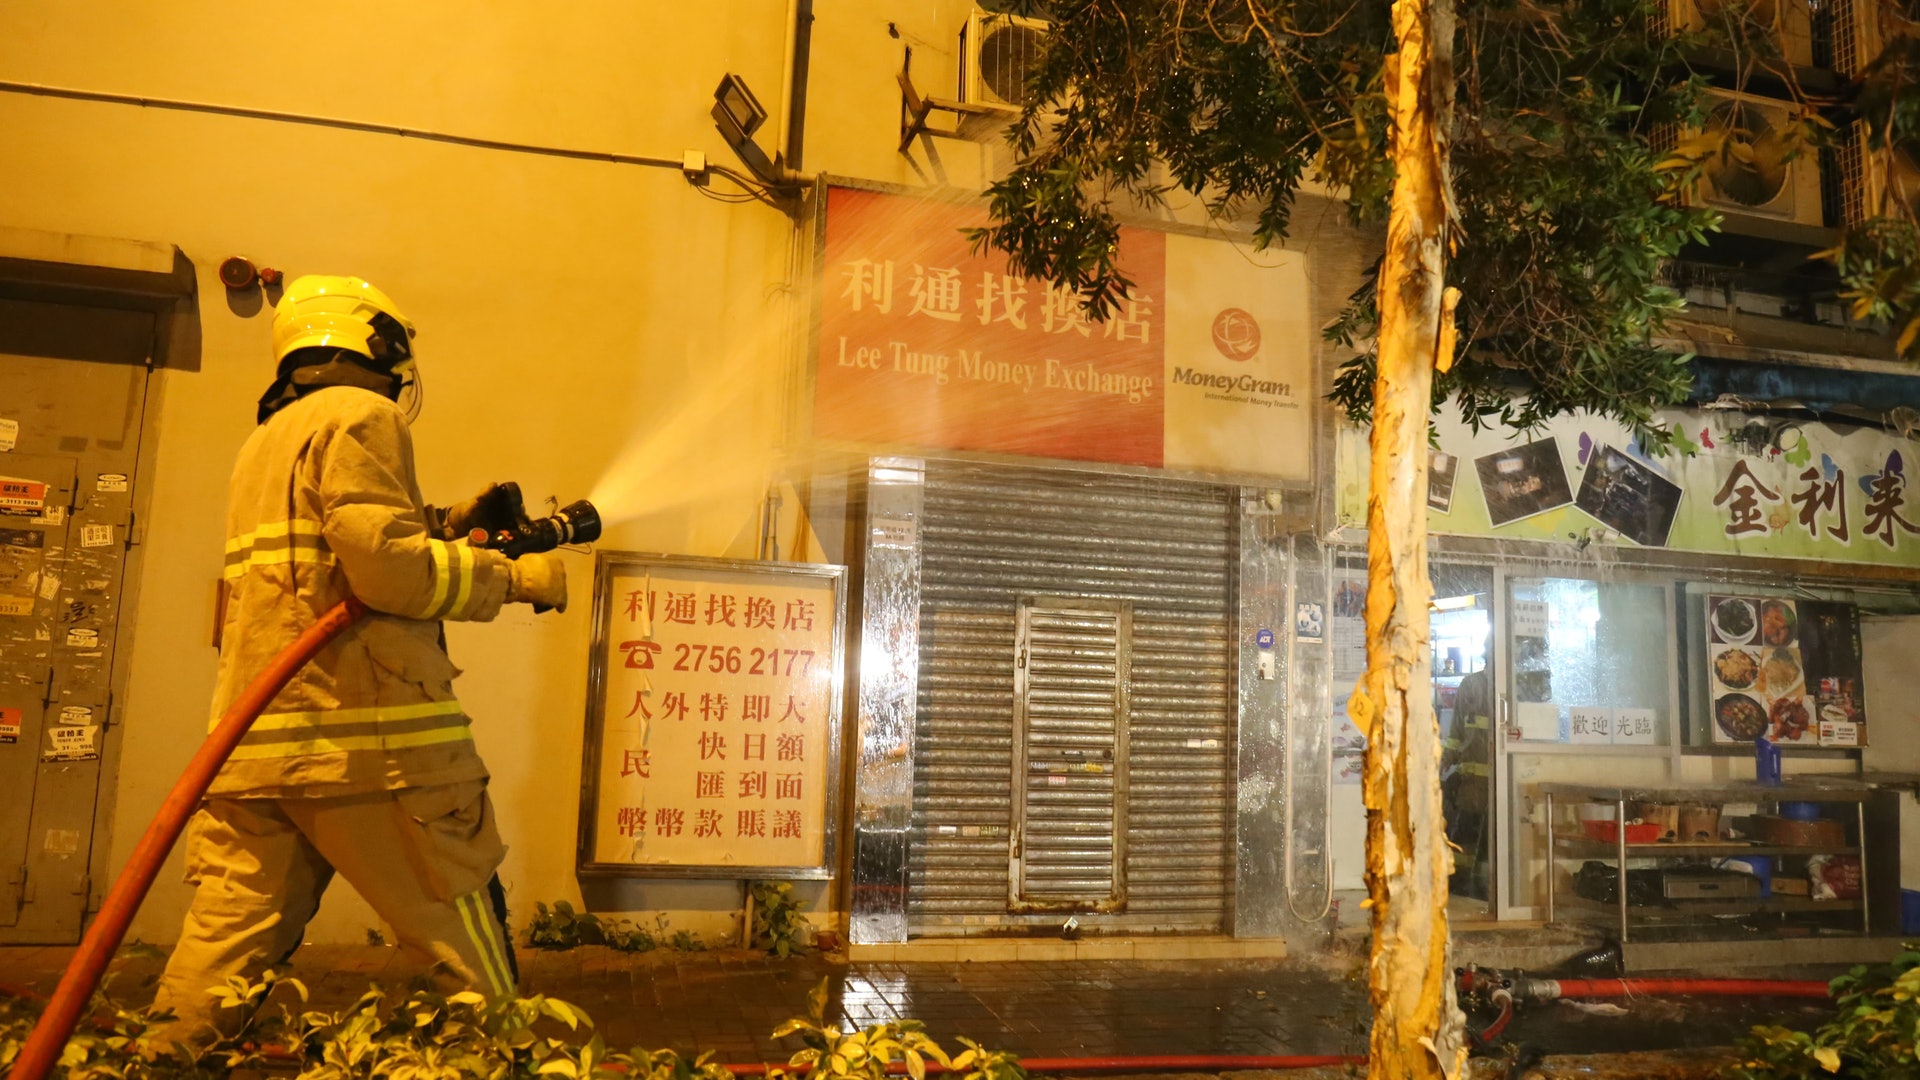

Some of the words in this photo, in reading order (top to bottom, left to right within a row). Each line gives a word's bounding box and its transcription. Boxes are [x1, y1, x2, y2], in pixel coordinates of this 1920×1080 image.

[840, 258, 1153, 344] 利通找換店
[837, 336, 881, 370] Lee
[889, 341, 949, 385] Tung
[958, 349, 1037, 393] Money
[1045, 359, 1152, 404] Exchange
[1172, 366, 1291, 397] MoneyGram
[1205, 392, 1249, 403] International
[1250, 398, 1272, 408] Money
[1274, 400, 1299, 409] Transfer
[623, 590, 815, 632] 利通找換店
[673, 643, 741, 673] 2756
[749, 647, 815, 677] 2177
[1572, 714, 1652, 737] 歡迎光臨
